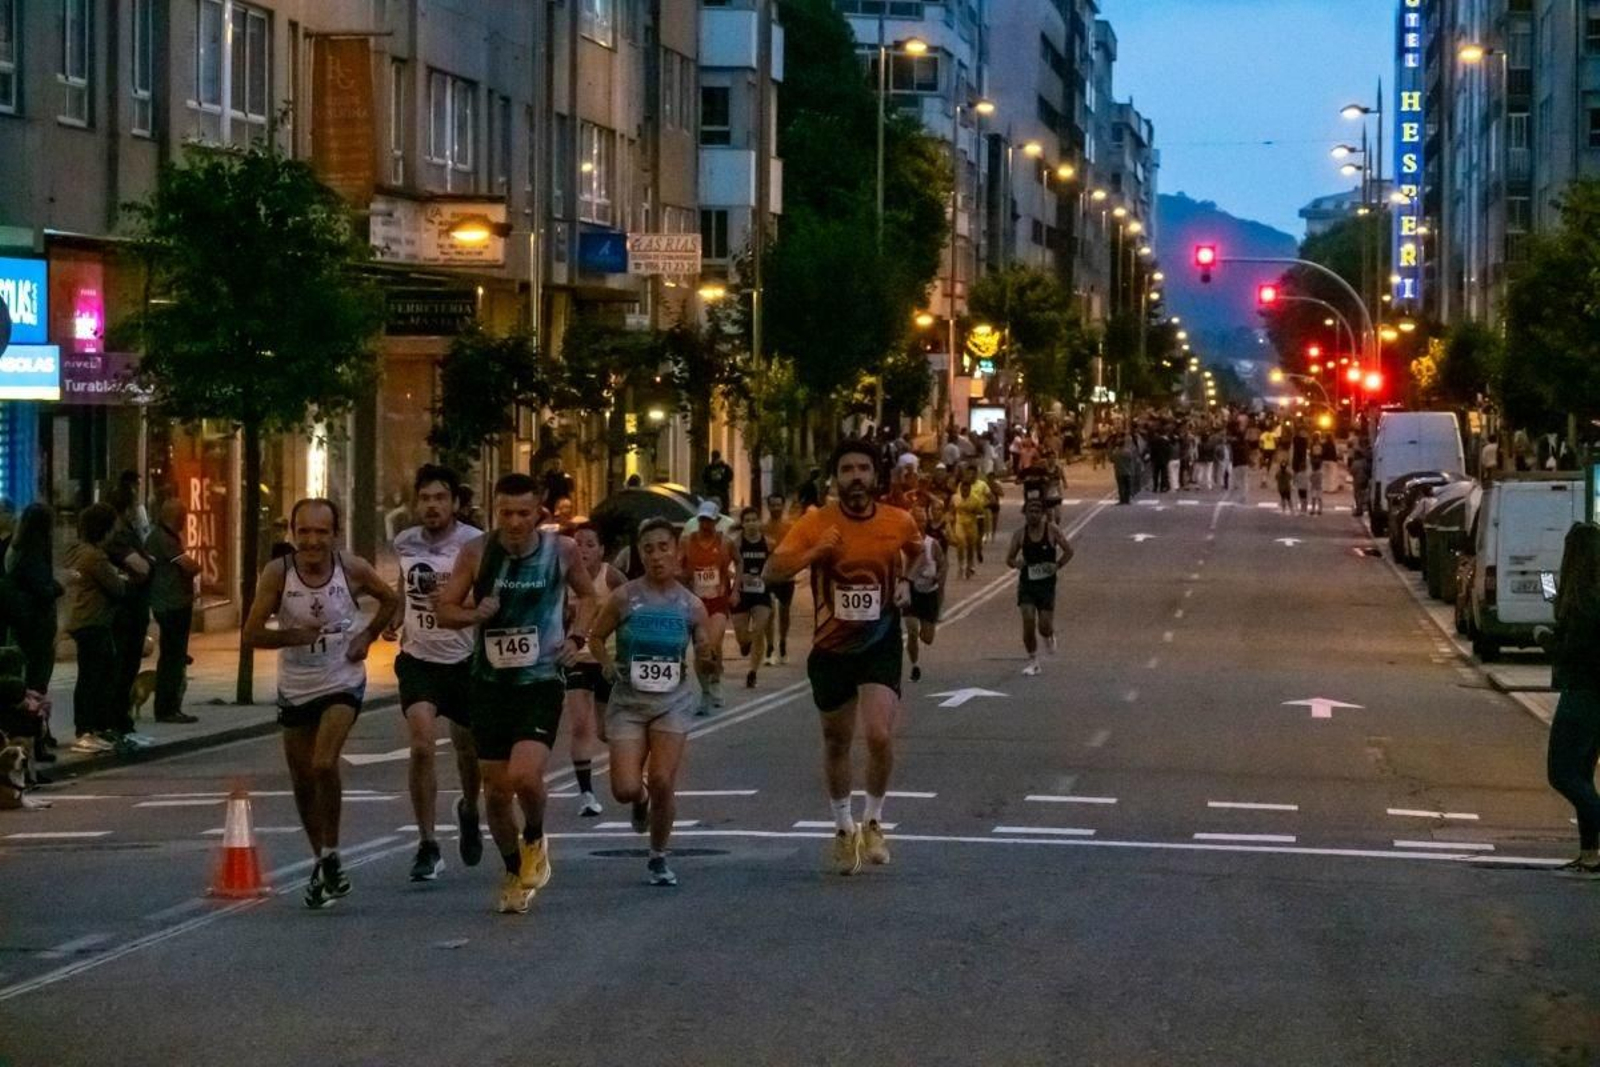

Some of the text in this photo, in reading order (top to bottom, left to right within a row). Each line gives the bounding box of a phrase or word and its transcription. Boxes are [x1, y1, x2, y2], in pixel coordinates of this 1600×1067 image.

[190, 477, 211, 511] RE
[186, 513, 216, 548] BAI
[841, 592, 873, 609] 309
[416, 613, 435, 630] 19
[494, 637, 531, 656] 146
[639, 663, 673, 680] 394
